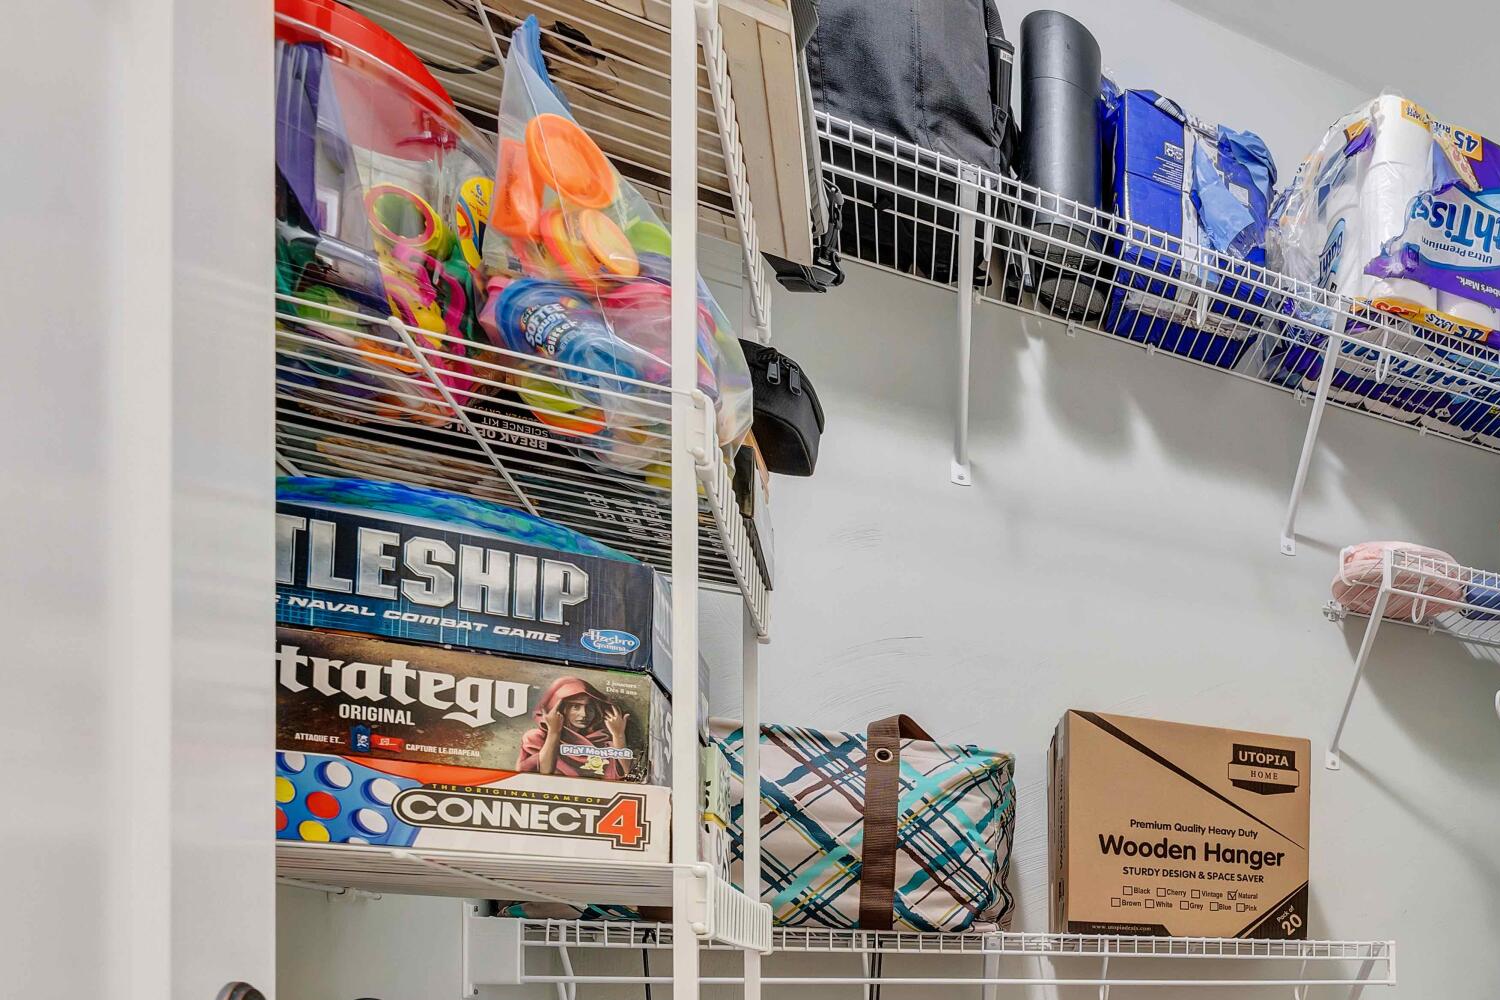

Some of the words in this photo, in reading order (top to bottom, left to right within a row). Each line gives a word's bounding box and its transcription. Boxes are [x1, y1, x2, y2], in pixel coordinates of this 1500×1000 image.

[1454, 129, 1479, 153] 45
[1421, 237, 1466, 257] Premium
[1468, 251, 1492, 265] Ultra
[1459, 276, 1480, 290] Mark
[525, 303, 565, 347] SOFTEE
[481, 416, 500, 428] KIT
[502, 421, 548, 437] SCIENCE
[499, 430, 548, 450] BREAK
[288, 596, 376, 617] NAVAL
[383, 609, 488, 633] COMBAT
[492, 626, 561, 644] GAME
[339, 704, 415, 726] ORIGINAL
[294, 732, 328, 743] ATTAQUE
[405, 743, 437, 753] CAPTURE
[1238, 751, 1289, 767] UTOPIA
[1250, 770, 1279, 780] HOME
[432, 783, 456, 792] THE
[465, 786, 536, 799] ORIGINAL
[543, 793, 579, 802] GAME
[401, 794, 600, 834] CONNECT
[597, 799, 643, 845] 4
[1130, 819, 1171, 831] Premium
[1174, 823, 1206, 836] Quality
[1208, 826, 1235, 838] Heavy
[1239, 828, 1258, 840] Duty
[1099, 834, 1196, 861] Wooden
[1204, 842, 1285, 870] Hanger
[1123, 867, 1160, 878] STURDY
[1162, 869, 1196, 879] DESIGN
[1207, 872, 1235, 881] SPACE
[1237, 874, 1264, 883] SAVER
[1134, 887, 1150, 895] Black
[1167, 889, 1186, 897] Cherry
[1202, 890, 1223, 899] Vintage
[1190, 902, 1203, 911] Grey
[1219, 903, 1231, 911] Blue
[1245, 904, 1257, 912] Pink
[1281, 911, 1302, 935] 20
